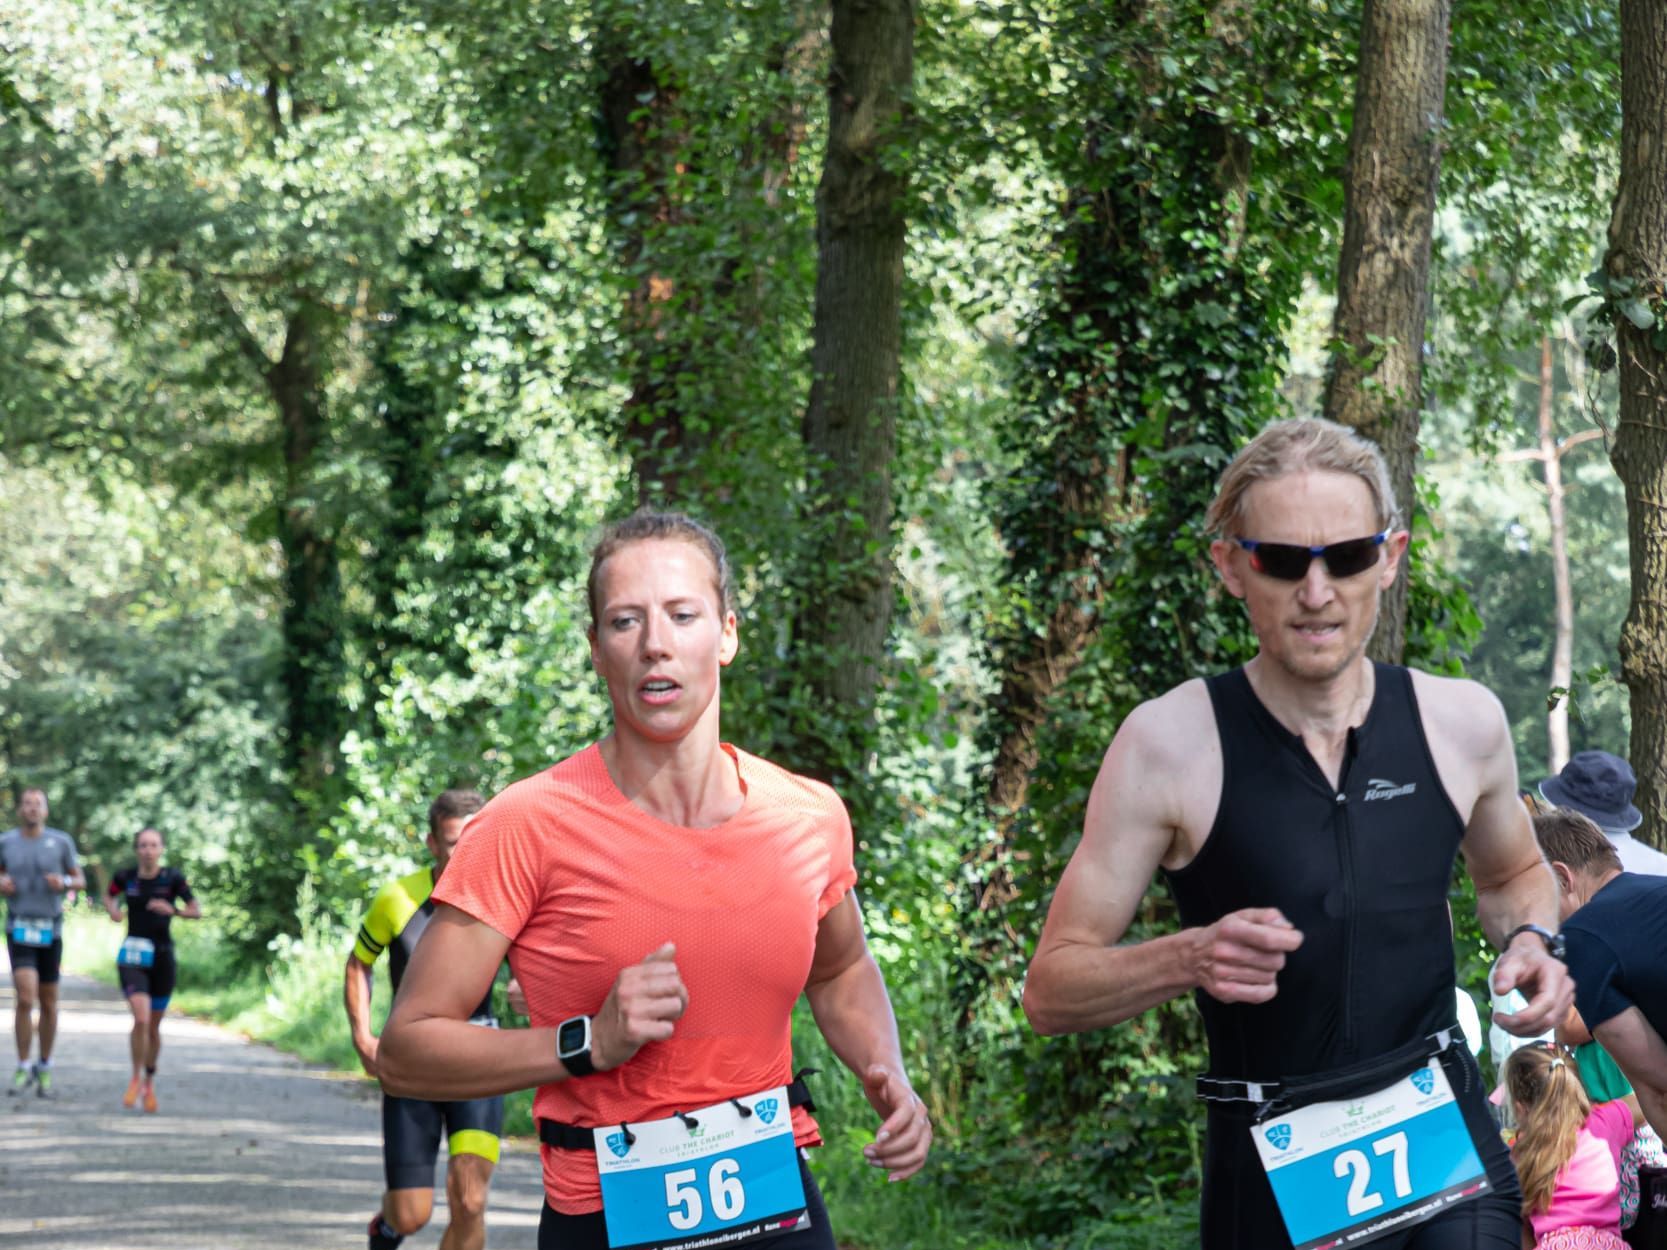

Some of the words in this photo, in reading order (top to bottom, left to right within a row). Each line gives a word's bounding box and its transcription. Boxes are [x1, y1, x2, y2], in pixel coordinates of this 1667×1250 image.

[683, 1141, 698, 1149] THE
[700, 1130, 735, 1145] CHARIOT
[1333, 1131, 1412, 1217] 27
[664, 1158, 746, 1230] 56
